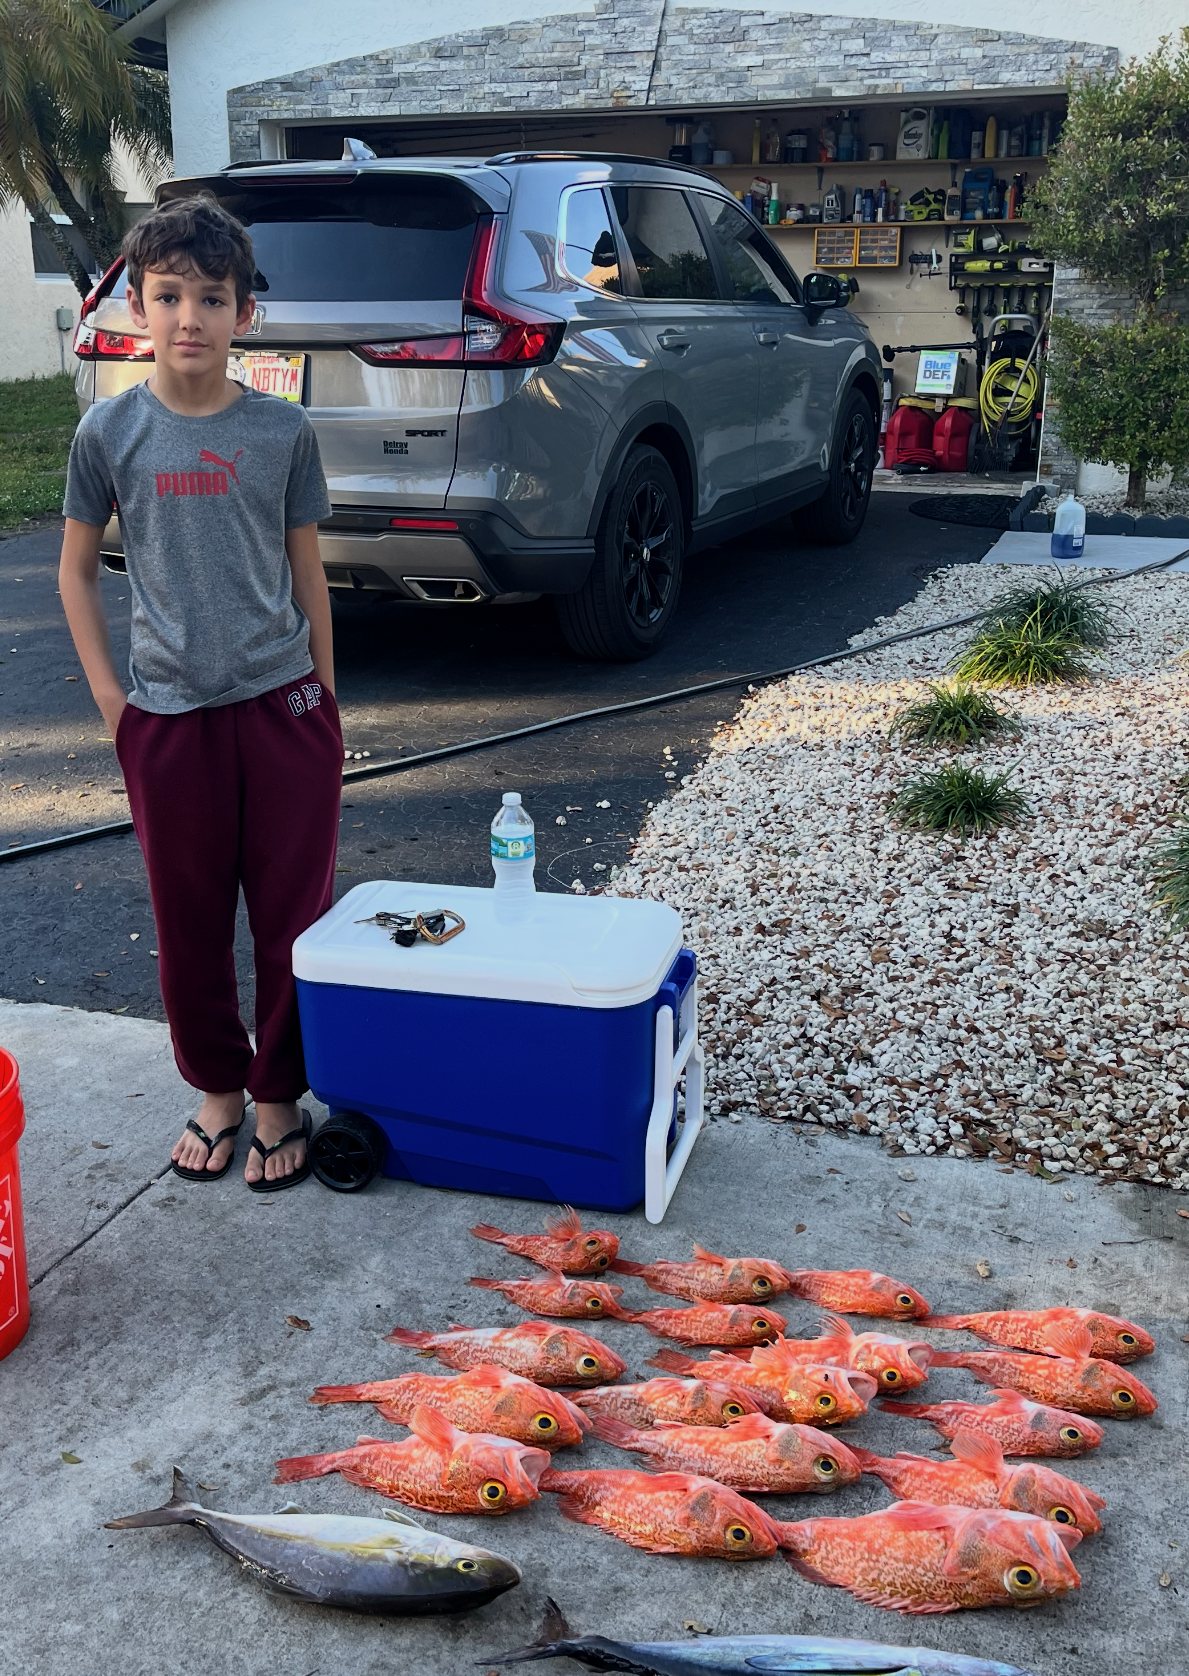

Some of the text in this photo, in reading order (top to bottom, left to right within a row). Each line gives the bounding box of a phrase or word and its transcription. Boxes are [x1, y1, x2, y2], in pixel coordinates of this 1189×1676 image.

[924, 360, 951, 369] Blue
[252, 367, 298, 392] NBTYM
[923, 369, 950, 380] DEF
[405, 429, 447, 437] SPORT
[383, 440, 408, 449] Delray
[156, 471, 228, 497] PUMA
[287, 683, 322, 717] GAP
